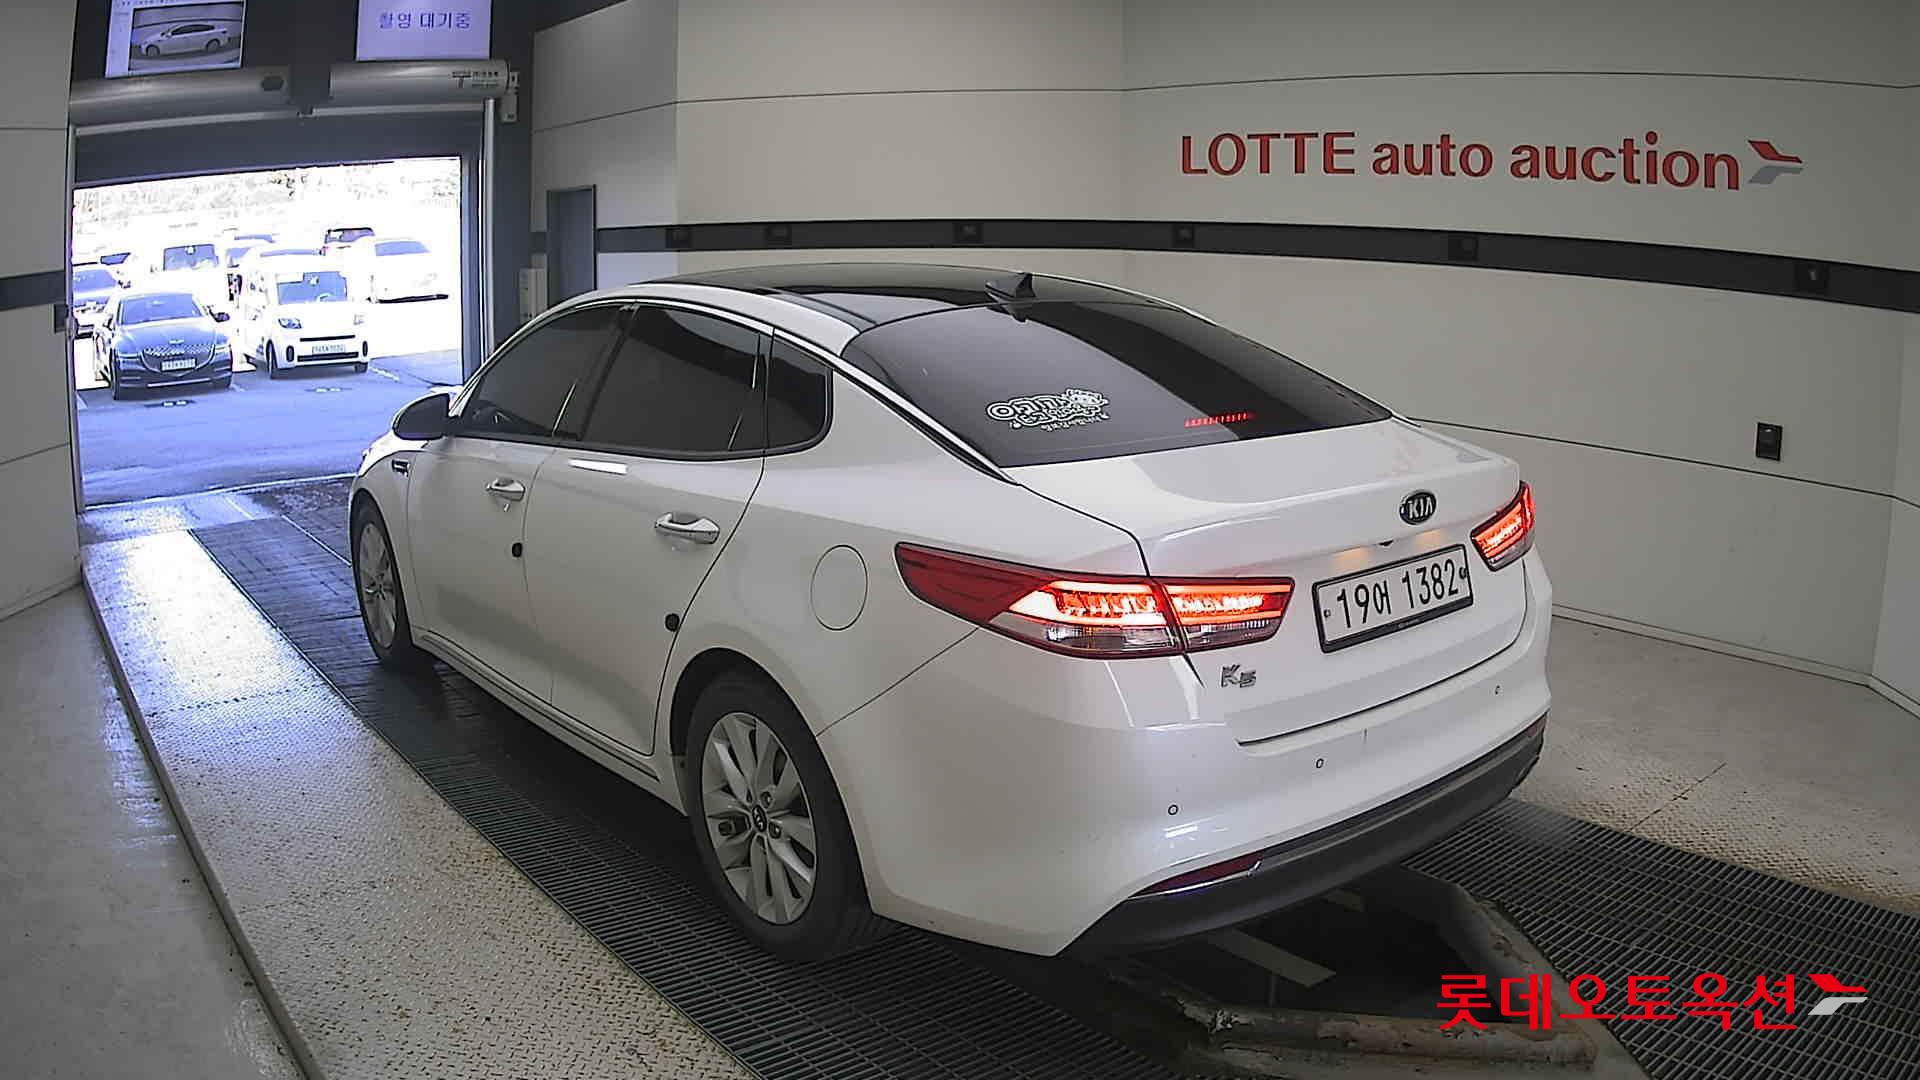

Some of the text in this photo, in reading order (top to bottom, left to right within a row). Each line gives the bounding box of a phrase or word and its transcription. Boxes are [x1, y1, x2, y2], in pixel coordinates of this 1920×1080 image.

[420, 12, 472, 29] 대기중
[1181, 131, 1740, 190] LOTTE auto auction
[1407, 496, 1433, 519] KIA
[1336, 559, 1459, 628] 19어 1382
[1220, 664, 1257, 689] K5
